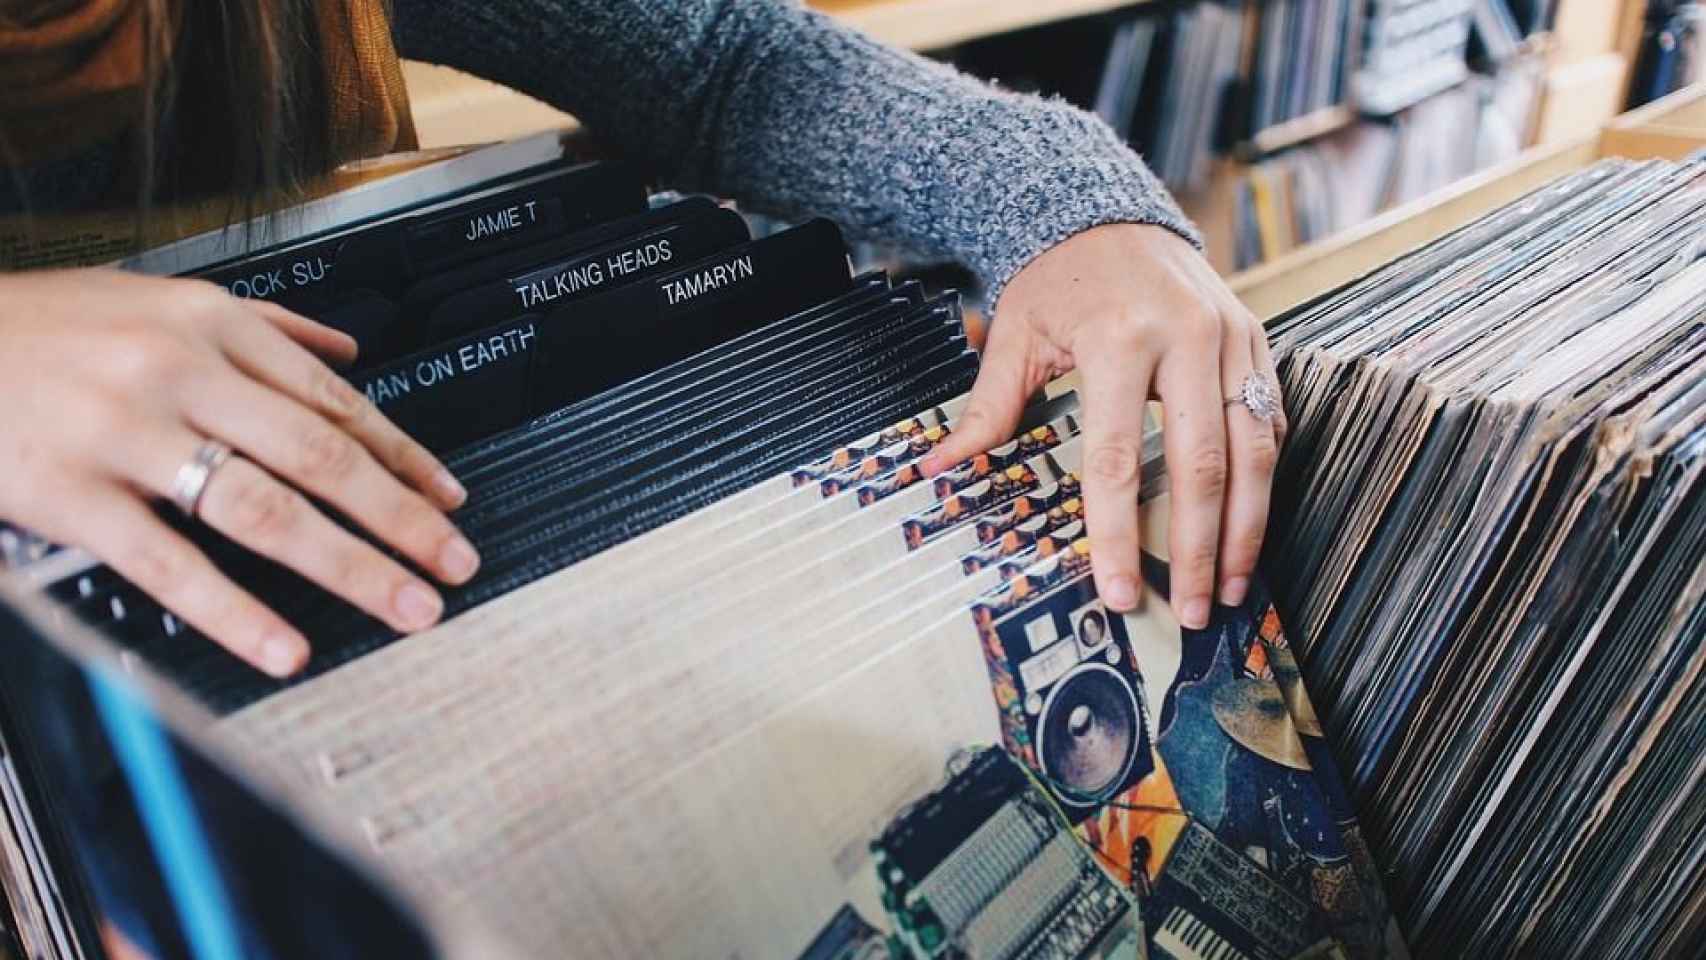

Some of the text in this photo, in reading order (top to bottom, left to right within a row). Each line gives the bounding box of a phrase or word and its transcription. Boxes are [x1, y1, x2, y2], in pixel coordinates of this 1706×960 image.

[465, 201, 537, 241] JAMIE T
[230, 256, 334, 299] OCK SU-
[515, 239, 673, 309] TALKING HEADS
[662, 255, 754, 305] TAMARYN
[415, 353, 454, 387] ON
[458, 323, 537, 372] EARTH
